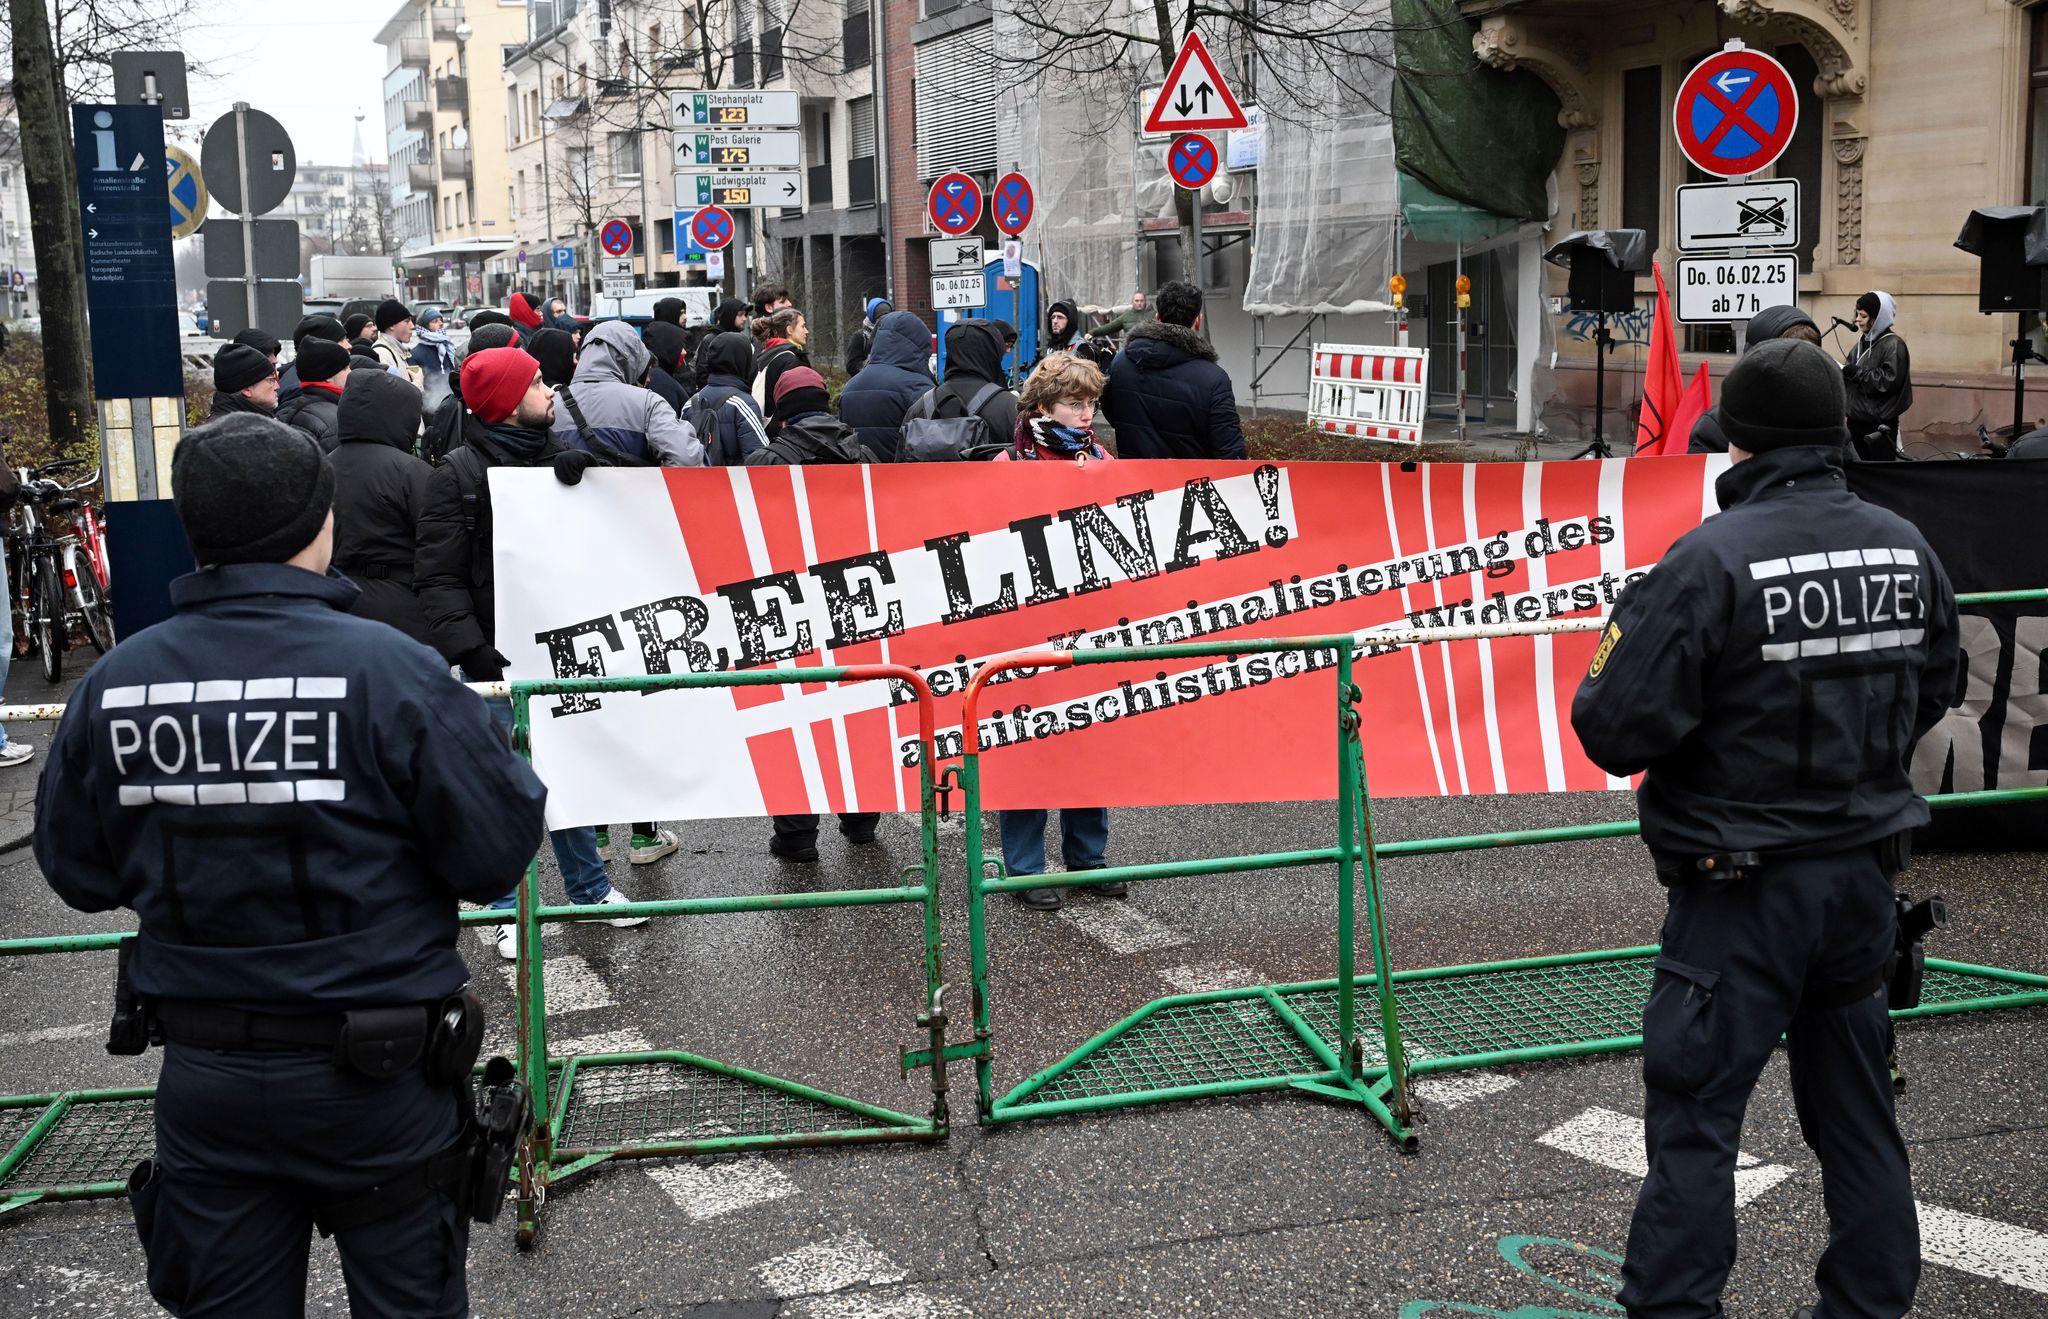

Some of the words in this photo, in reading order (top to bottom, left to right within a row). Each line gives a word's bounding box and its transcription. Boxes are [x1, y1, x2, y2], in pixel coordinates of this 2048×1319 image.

[695, 96, 705, 105] W
[708, 94, 763, 106] Stephanplatz
[720, 108, 746, 122] 123
[697, 136, 708, 145] W
[710, 135, 728, 144] Post
[732, 135, 761, 144] Galerie
[722, 149, 747, 163] 175
[699, 177, 709, 186] W
[712, 176, 766, 187] Ludwigsplatz
[723, 190, 750, 203] 150
[1687, 267, 1711, 285] Do.
[1717, 264, 1786, 285] 06.02.25
[936, 281, 948, 290] Do.
[949, 278, 980, 290] 06.02.25
[948, 295, 957, 304] ab
[1712, 293, 1730, 313] ab
[1736, 293, 1745, 312] 7
[1751, 293, 1760, 312] h
[535, 550, 904, 718] FREE
[924, 464, 1289, 626] LINA!
[1047, 531, 1516, 672] Kriminalisierung
[1525, 515, 1616, 558] des
[1763, 574, 1925, 635] POLIZEI
[110, 711, 337, 775] POLIZEI
